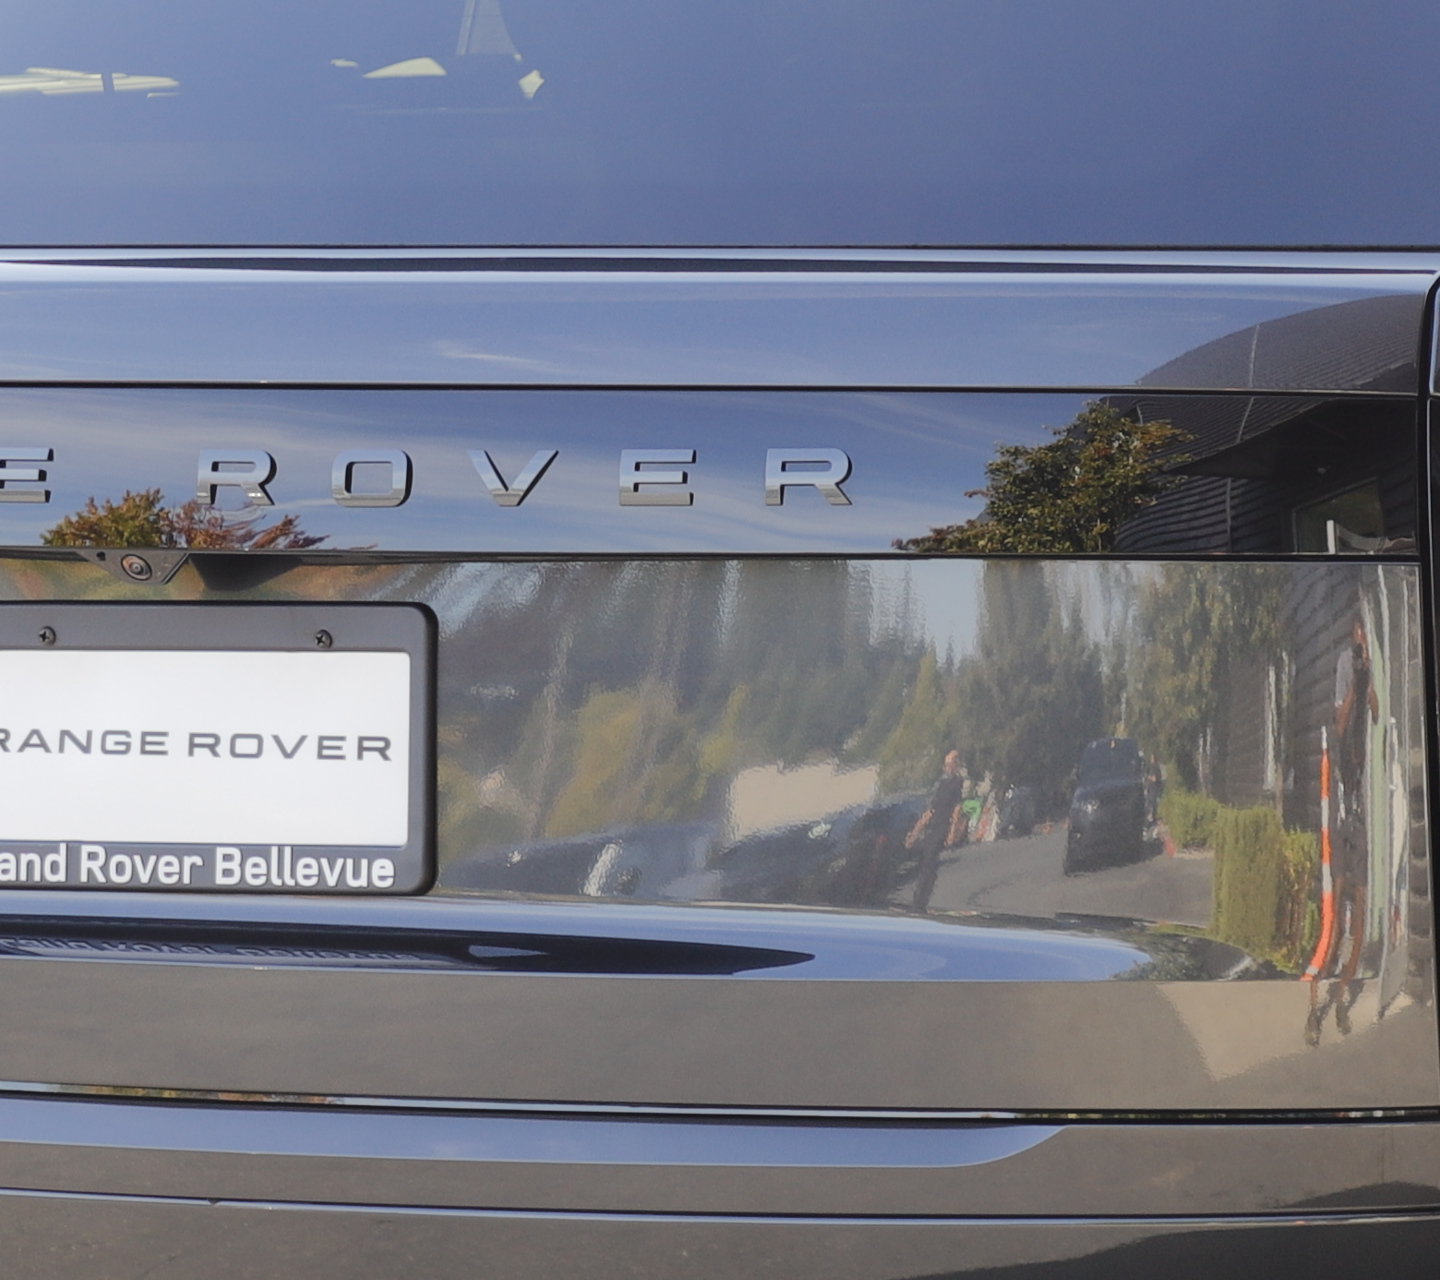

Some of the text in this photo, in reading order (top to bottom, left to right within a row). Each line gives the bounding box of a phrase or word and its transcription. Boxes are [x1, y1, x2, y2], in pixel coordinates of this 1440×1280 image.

[195, 447, 854, 508] ROVER
[187, 732, 392, 762] ROVER
[79, 845, 203, 886] Rover
[214, 847, 396, 889] Bellevue
